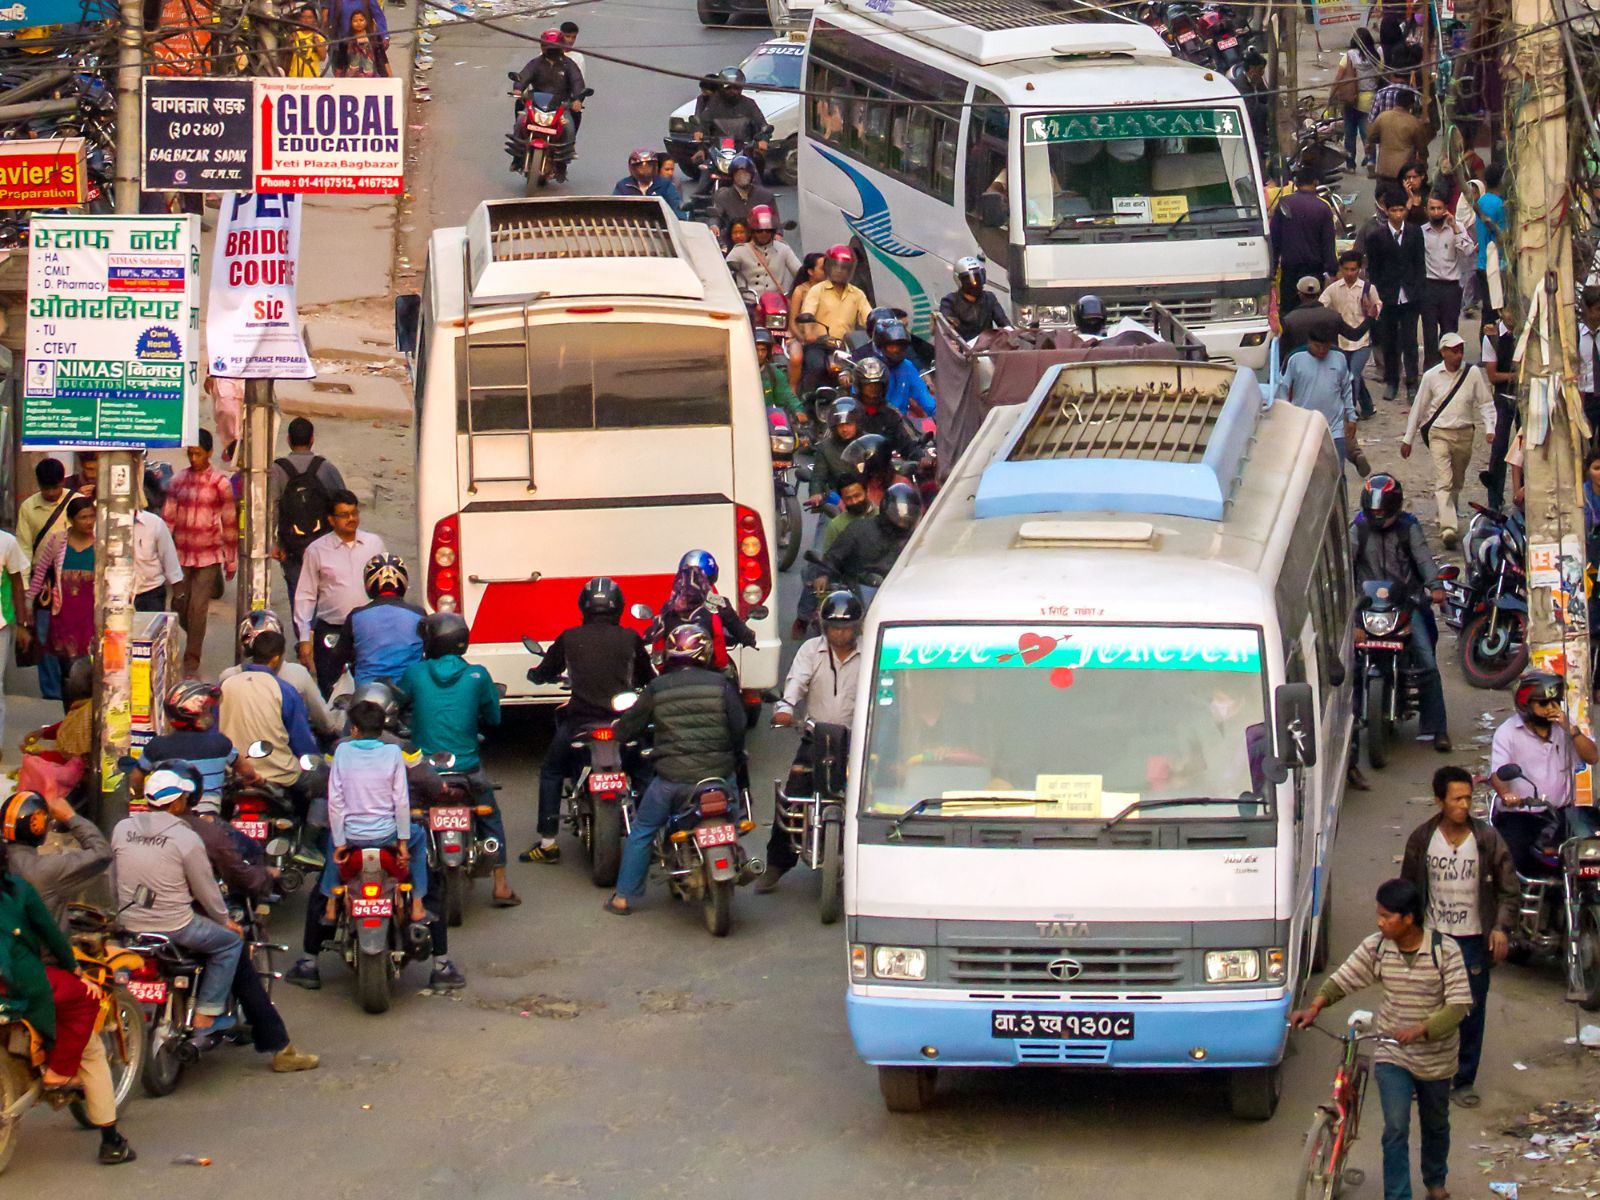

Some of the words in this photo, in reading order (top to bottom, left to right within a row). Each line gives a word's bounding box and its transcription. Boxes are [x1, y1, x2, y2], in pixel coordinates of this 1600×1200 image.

[151, 97, 209, 115] बागबजार
[213, 97, 246, 116] सडक
[277, 93, 399, 137] GLOBAL
[278, 137, 399, 153] EDUCATION
[150, 149, 209, 163] BAGBAZAR
[214, 149, 247, 162] SADAK
[274, 160, 300, 169] Yeti
[261, 177, 291, 188] Phone
[357, 177, 400, 188] 4167524
[0, 188, 75, 202] Preparation
[34, 228, 114, 250] स्टाफ
[129, 223, 182, 250] नर्स
[45, 253, 59, 263] HA
[110, 256, 138, 265] NIMAS
[44, 266, 70, 276] CMLT
[44, 280, 54, 289] D.
[57, 279, 107, 292] Pharmacy
[254, 300, 284, 320] SLC
[43, 324, 56, 336] TU
[150, 330, 168, 338] Own
[43, 342, 77, 354] CTEVT
[147, 340, 171, 349] Hostel
[56, 361, 124, 378] NIMAS
[127, 361, 183, 378] निमास
[56, 379, 123, 390] EDUCATION
[116, 390, 139, 398] Your
[145, 391, 181, 400] Future
[1036, 922, 1091, 939] TATA
